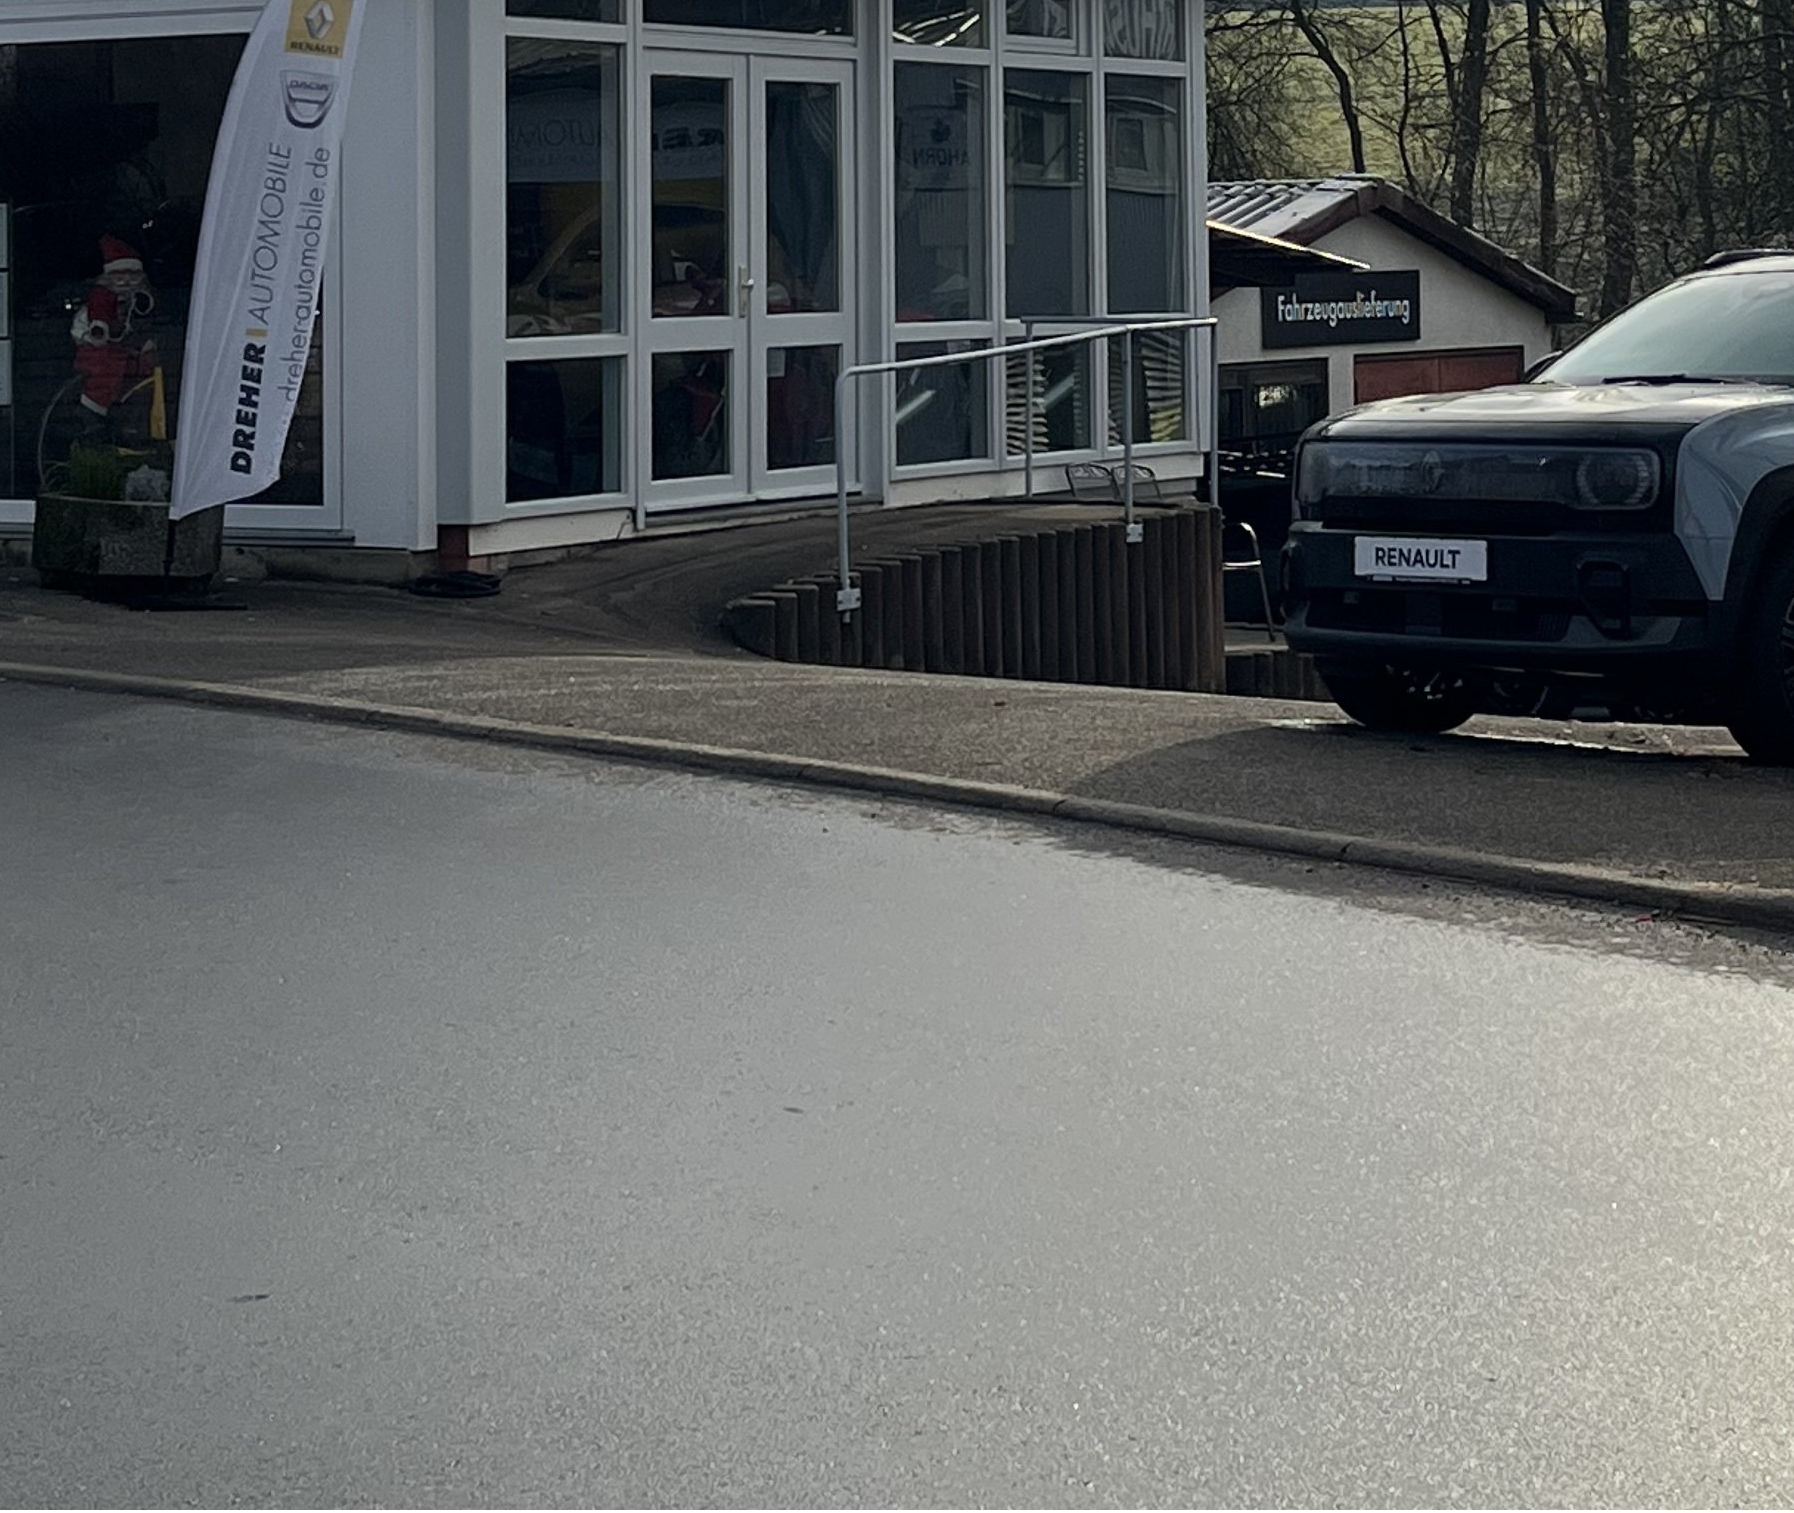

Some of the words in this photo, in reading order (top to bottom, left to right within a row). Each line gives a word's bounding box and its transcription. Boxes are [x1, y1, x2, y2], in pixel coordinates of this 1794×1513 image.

[290, 41, 339, 55] RENAULT
[230, 343, 266, 474] DREHER
[248, 142, 292, 325] AUTOMOBILE
[1278, 290, 1410, 327] Fahrzeugauslieferung
[1374, 547, 1460, 569] RENAULT
